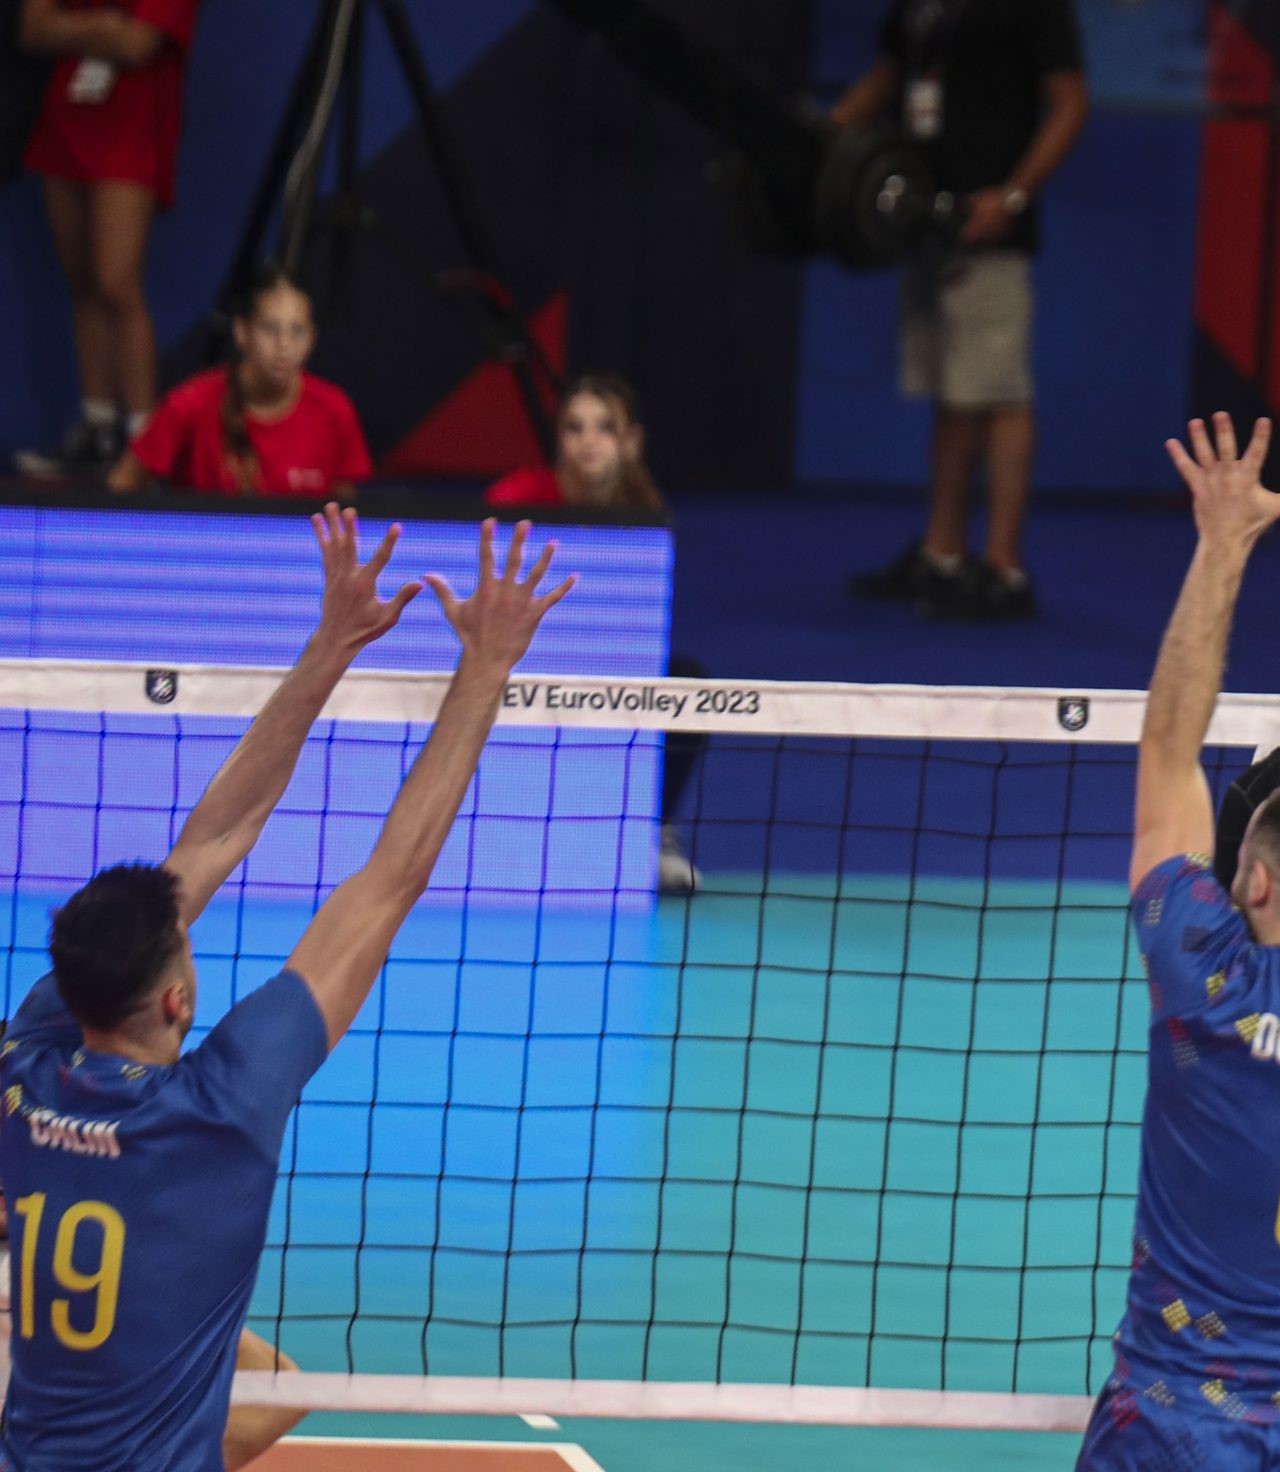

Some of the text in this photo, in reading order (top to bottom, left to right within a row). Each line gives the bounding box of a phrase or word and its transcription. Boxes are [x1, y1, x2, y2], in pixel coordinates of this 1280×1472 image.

[503, 683, 760, 718] EV EuroVolley 2023
[15, 1191, 126, 1351] 19
